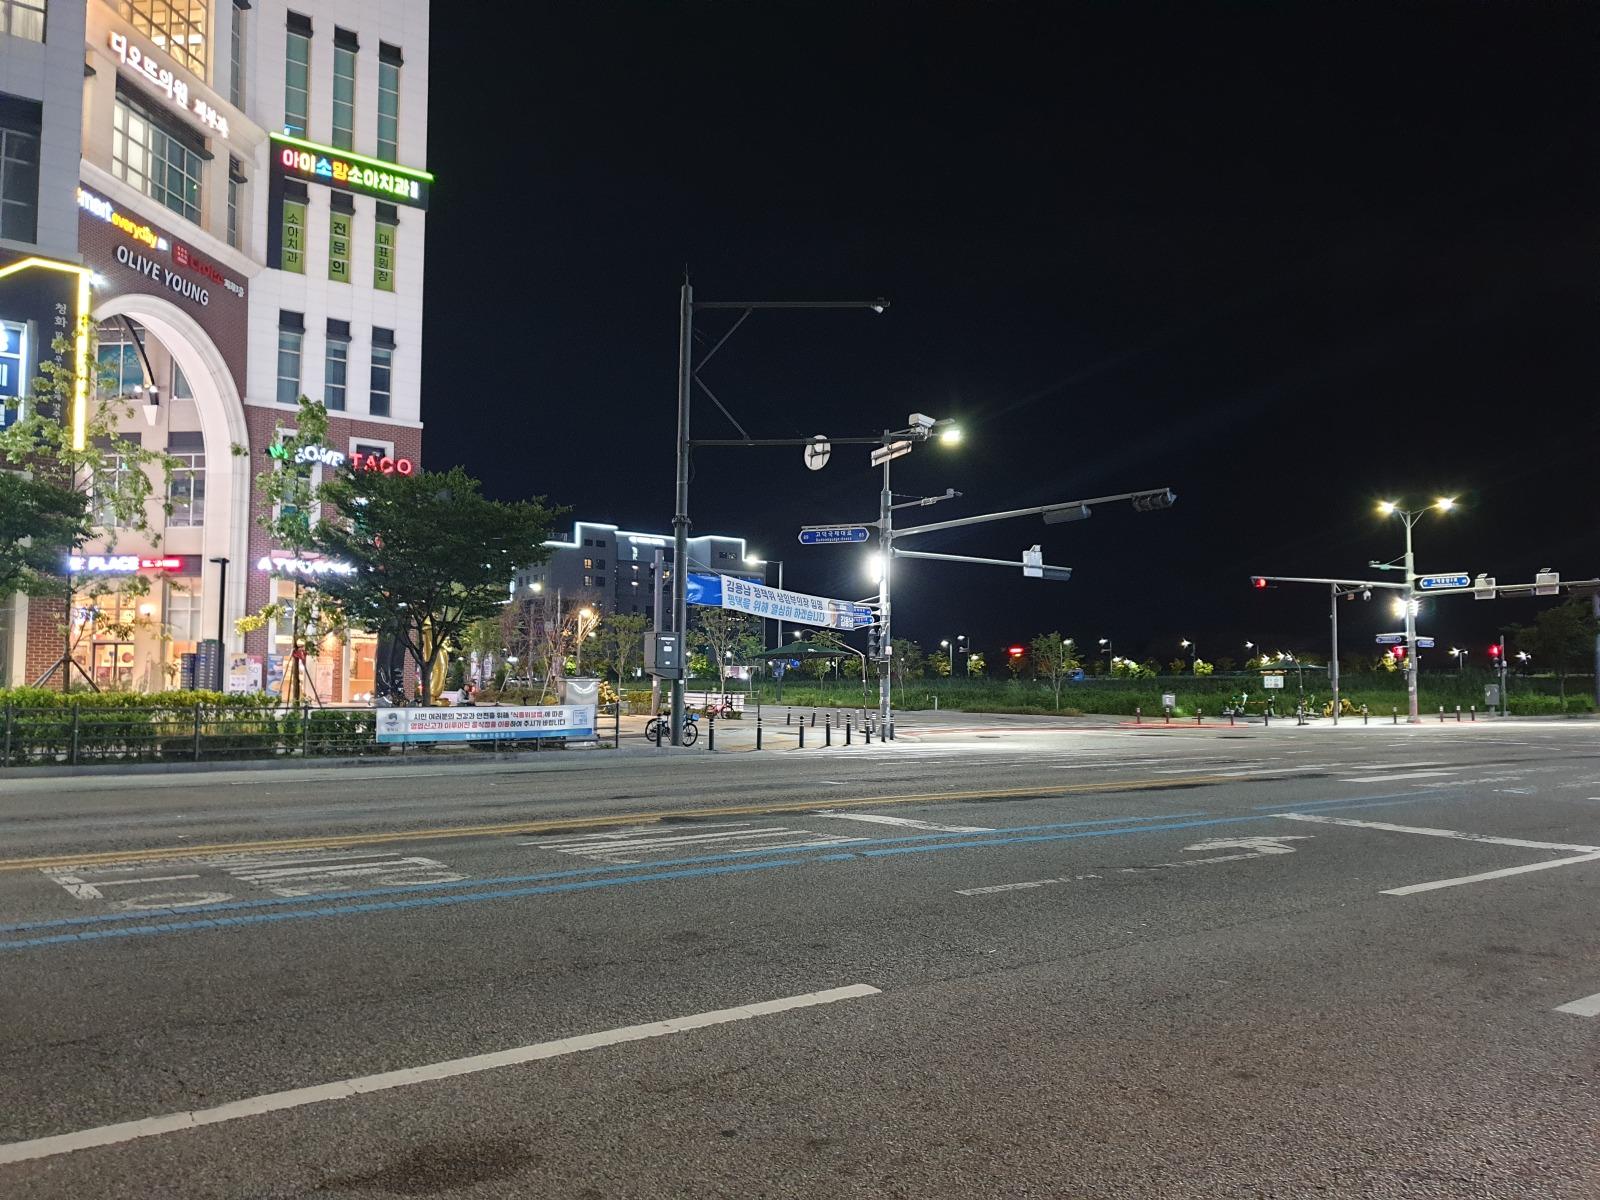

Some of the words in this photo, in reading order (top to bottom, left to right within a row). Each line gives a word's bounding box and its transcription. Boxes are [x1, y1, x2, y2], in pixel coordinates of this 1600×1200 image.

[287, 214, 299, 264] 소아치과
[332, 222, 347, 275] 전문의
[377, 233, 390, 282] 대표원장
[115, 245, 161, 281] OLIVE
[164, 268, 210, 306] YOUNG
[349, 453, 412, 474] TACO
[726, 580, 751, 597] 김용남
[777, 592, 810, 609] 상임부의장
[727, 594, 751, 609] 평택을
[753, 600, 769, 614] 위해
[771, 604, 792, 618] 열심히
[793, 608, 826, 623] 하겠습니다
[410, 721, 443, 730] 영업신고가
[444, 721, 471, 729] 이루어진
[542, 718, 566, 727] 바랍니다
[413, 712, 427, 720] 시민
[428, 712, 455, 720] 여러분의
[456, 711, 475, 720] 건강과
[476, 711, 495, 719] 안전을
